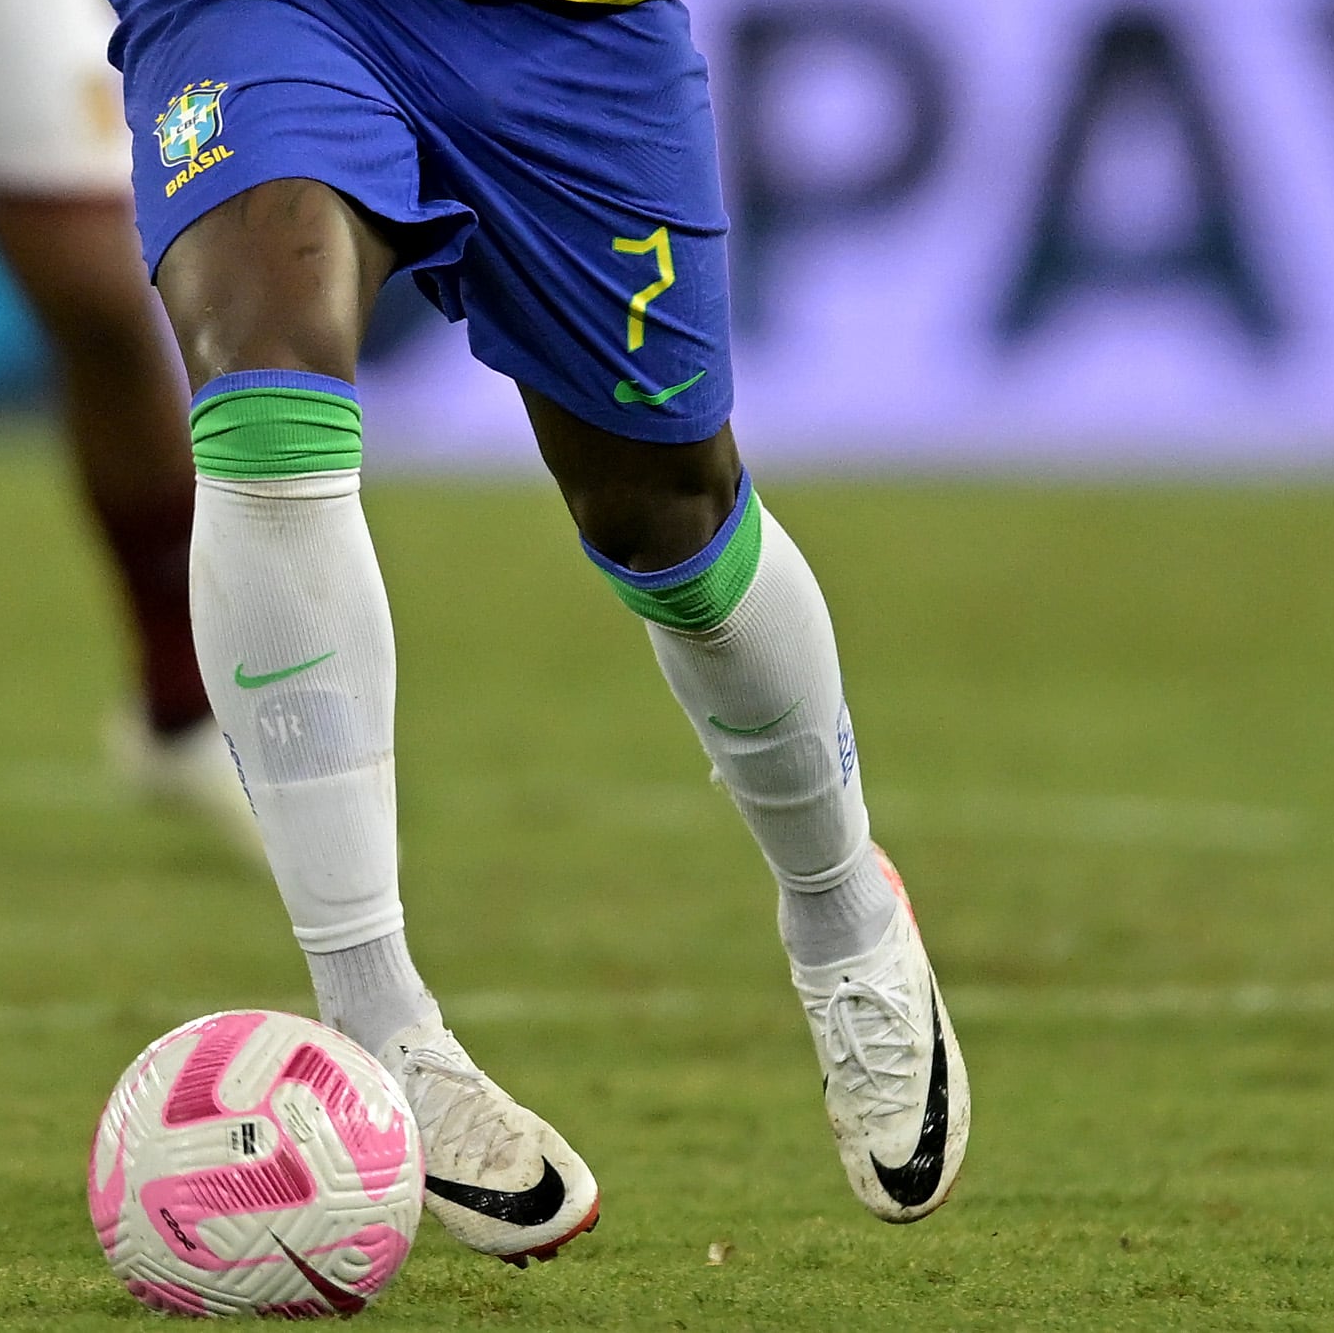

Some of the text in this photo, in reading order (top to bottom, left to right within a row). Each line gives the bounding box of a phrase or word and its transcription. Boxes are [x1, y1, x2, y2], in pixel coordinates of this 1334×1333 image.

[175, 113, 201, 134] CBF
[164, 144, 235, 198] BRASIL
[612, 226, 675, 353] 7
